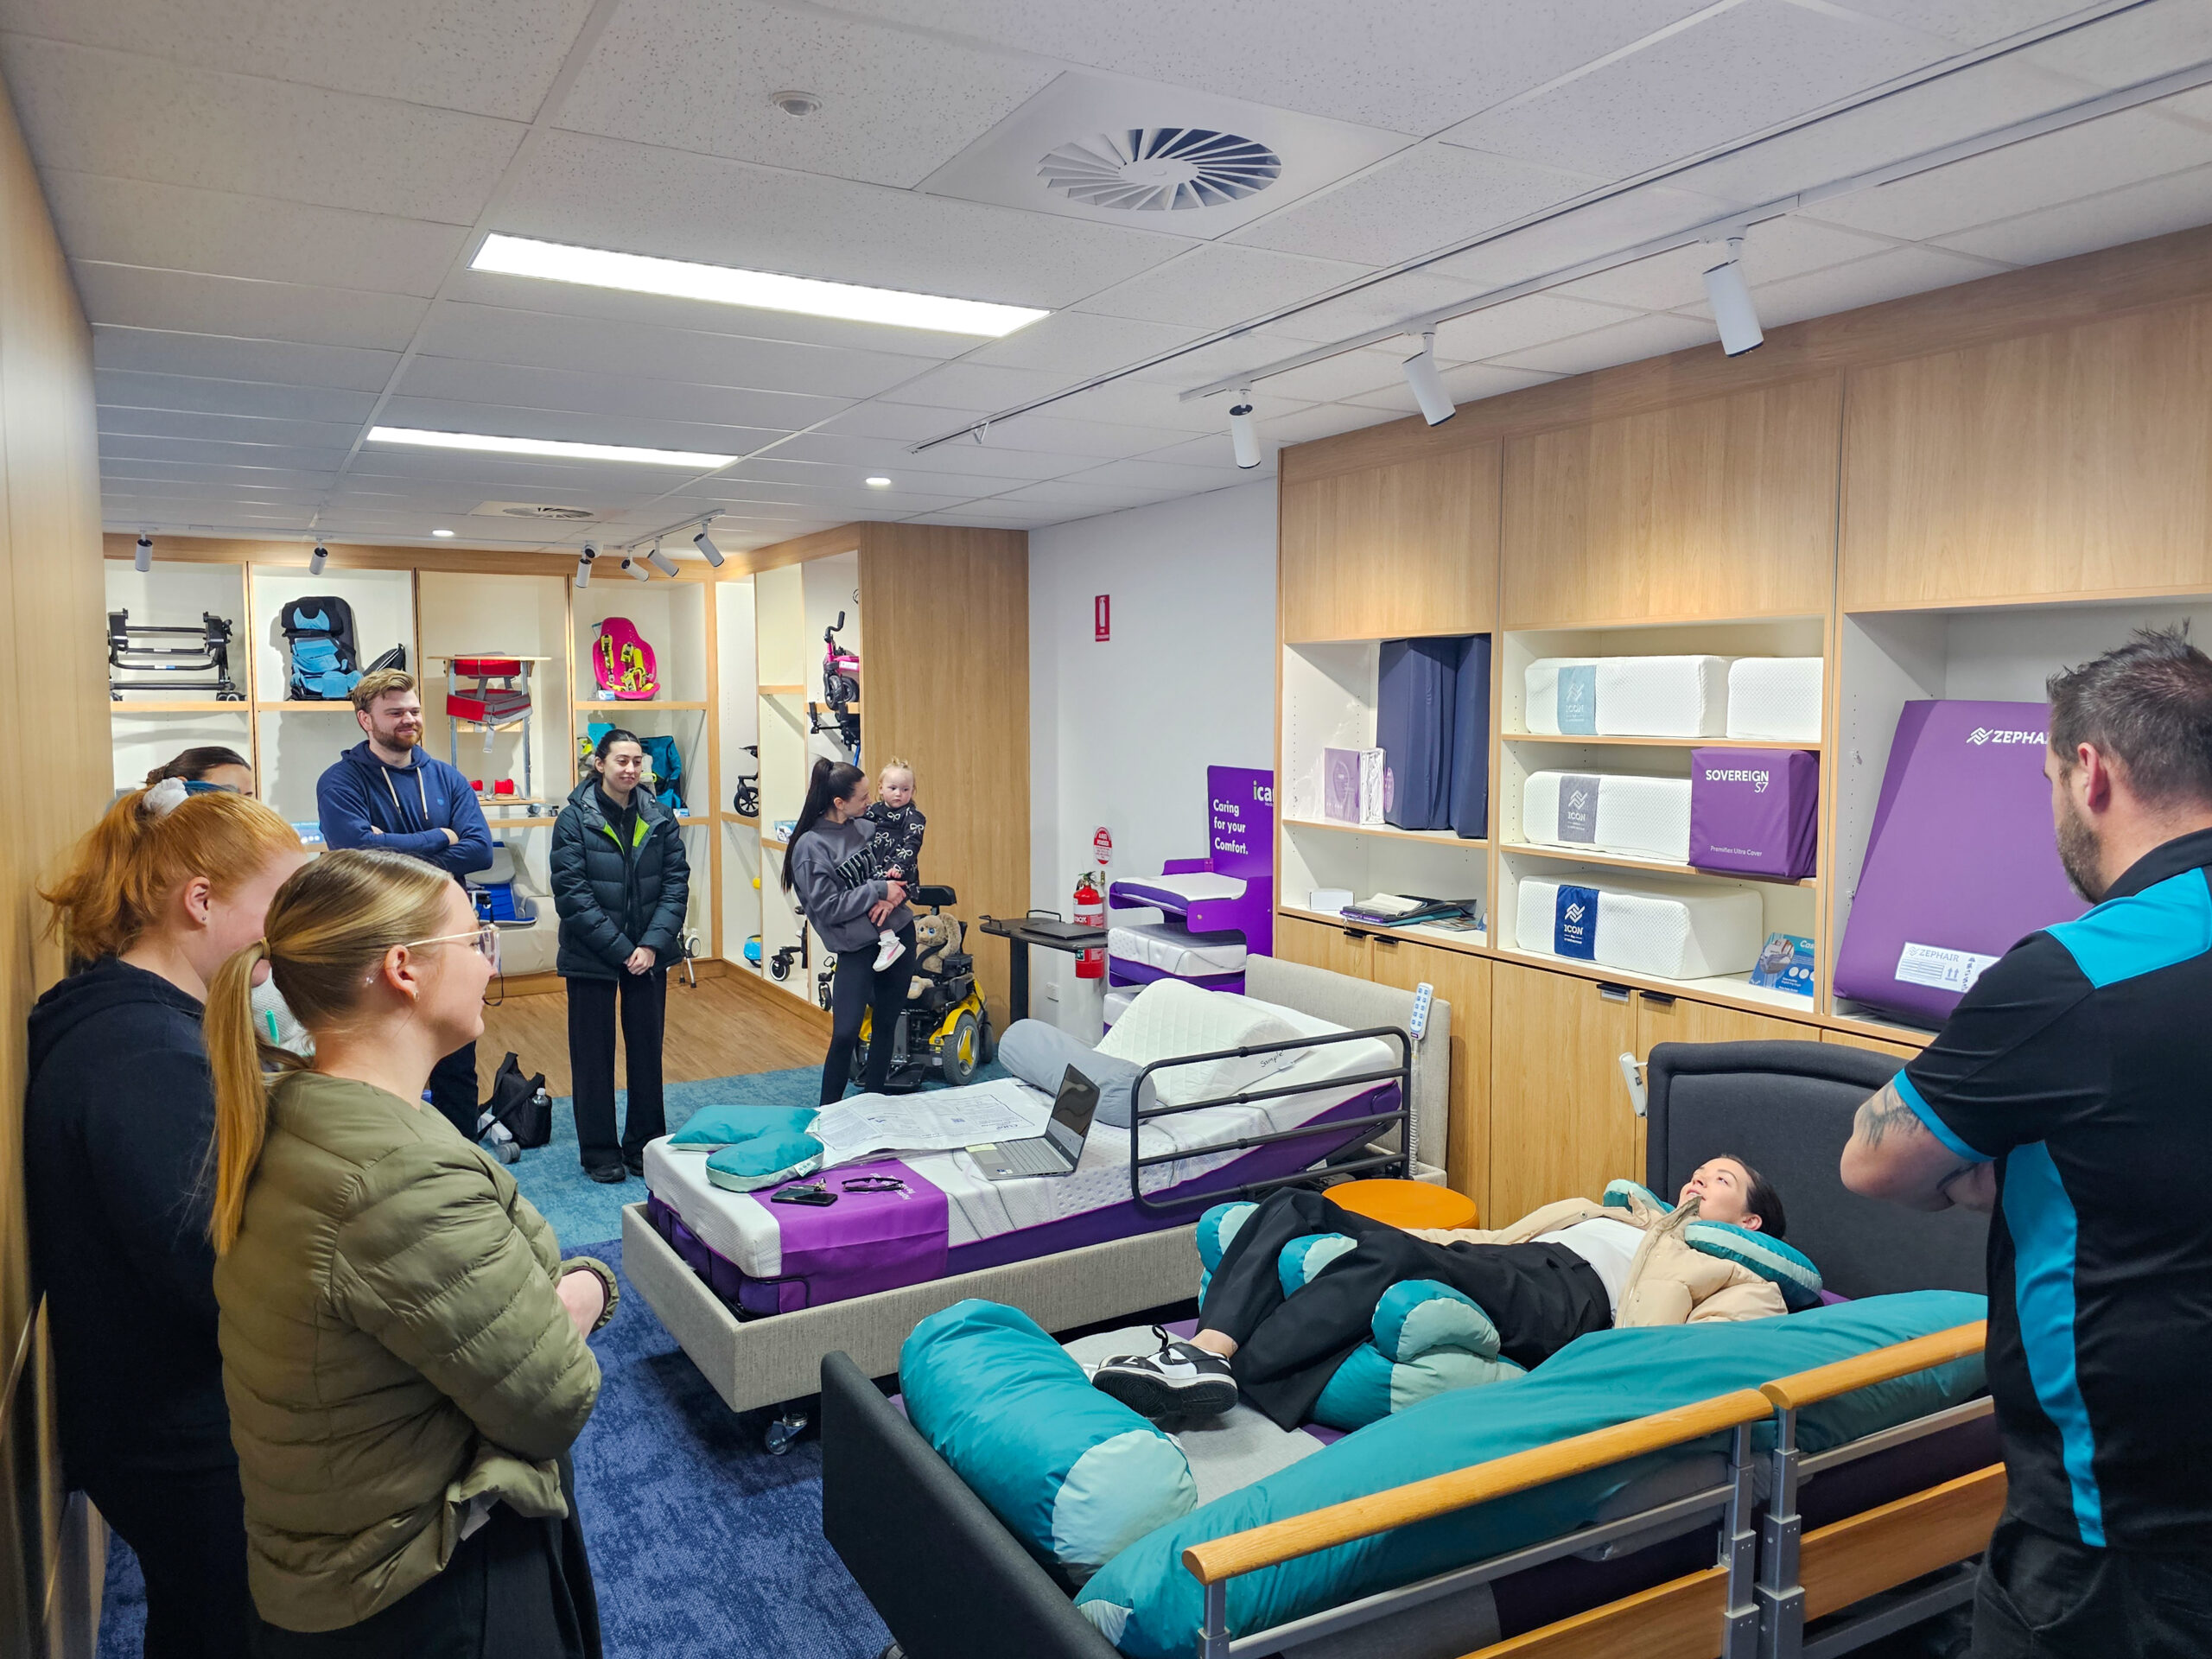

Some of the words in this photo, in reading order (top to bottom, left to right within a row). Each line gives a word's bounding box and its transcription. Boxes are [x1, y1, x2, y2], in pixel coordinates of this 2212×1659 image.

[1706, 769, 1769, 782] SOVEREIGN
[1253, 779, 1274, 802] ica
[1754, 781, 1769, 793] S7
[1213, 798, 1240, 817] Caring
[1567, 811, 1586, 822] ICON
[1213, 816, 1225, 830] for
[1227, 821, 1246, 834] your
[1214, 836, 1249, 855] Comfort.
[1563, 924, 1584, 936] ICON
[1919, 949, 1960, 962] ZEPHAIR
